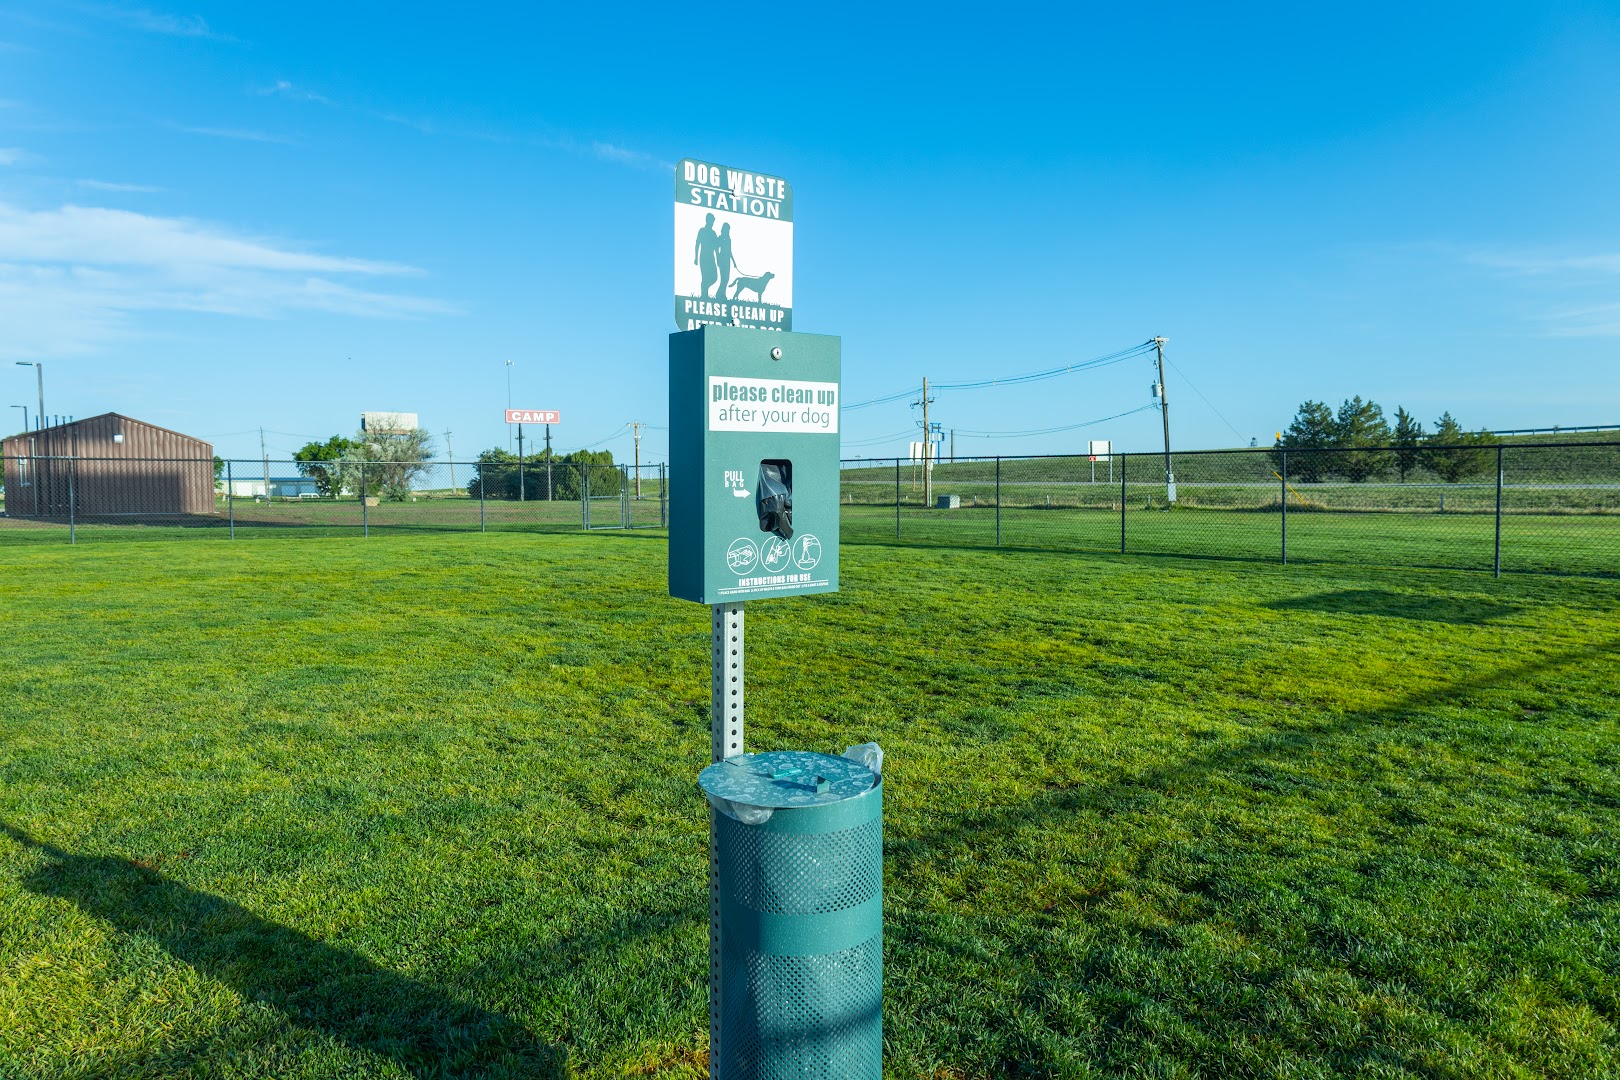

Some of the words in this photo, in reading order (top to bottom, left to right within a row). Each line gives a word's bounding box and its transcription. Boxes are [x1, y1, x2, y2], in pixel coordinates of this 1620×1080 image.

[684, 160, 720, 187] DOG
[726, 169, 785, 200] WASTE
[690, 187, 780, 219] STATION
[684, 299, 727, 318] PLEASE
[731, 304, 766, 321] CLEAN
[769, 309, 785, 323] UP
[712, 382, 767, 402] please
[771, 385, 813, 404] clean
[817, 390, 835, 406] up
[511, 411, 555, 422] CAMP
[718, 403, 757, 422] after
[761, 410, 797, 427] your
[801, 407, 830, 428] dog
[724, 470, 744, 482] PULL
[724, 480, 744, 488] BAG
[738, 575, 786, 587] INSTRUCTIONS
[786, 574, 799, 582] FOR
[799, 573, 811, 581] USE
